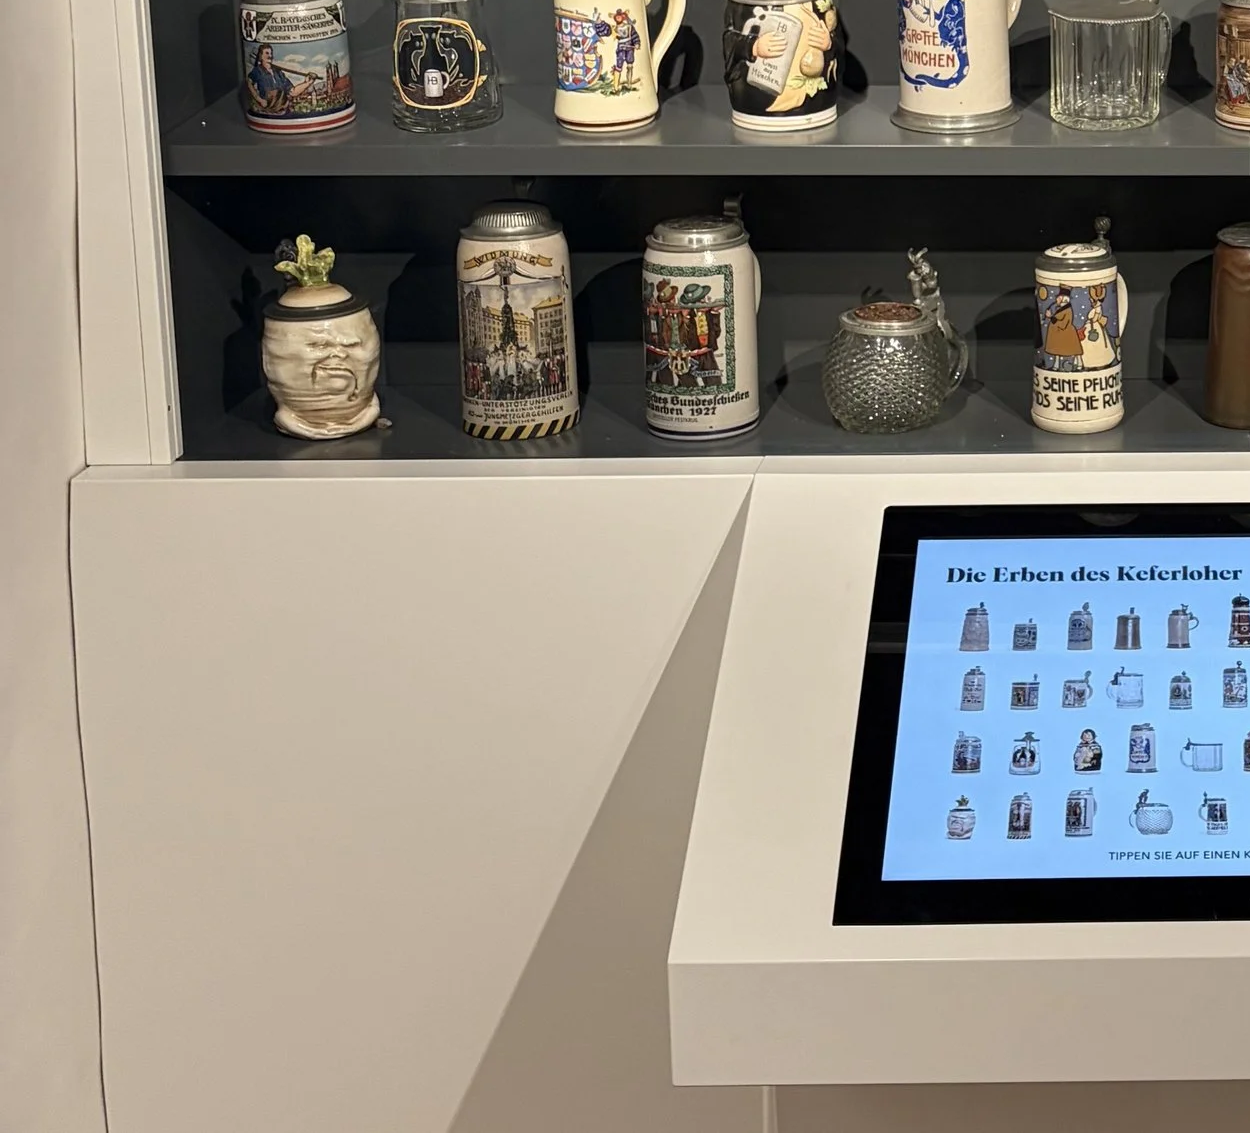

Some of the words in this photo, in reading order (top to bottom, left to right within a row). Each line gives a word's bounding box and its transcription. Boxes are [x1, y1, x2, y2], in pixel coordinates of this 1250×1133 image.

[1043, 375, 1080, 394] SEINE
[688, 407, 717, 417] 1927
[1056, 394, 1100, 412] SEINE
[946, 567, 986, 583] Die
[993, 567, 1065, 583] Erben
[1070, 566, 1110, 582] des
[1116, 565, 1243, 582] Keferloher
[1108, 851, 1150, 861] TIPPEN
[1154, 850, 1172, 860] SIE
[1175, 850, 1199, 860] AUF
[1203, 850, 1240, 860] EINEN
